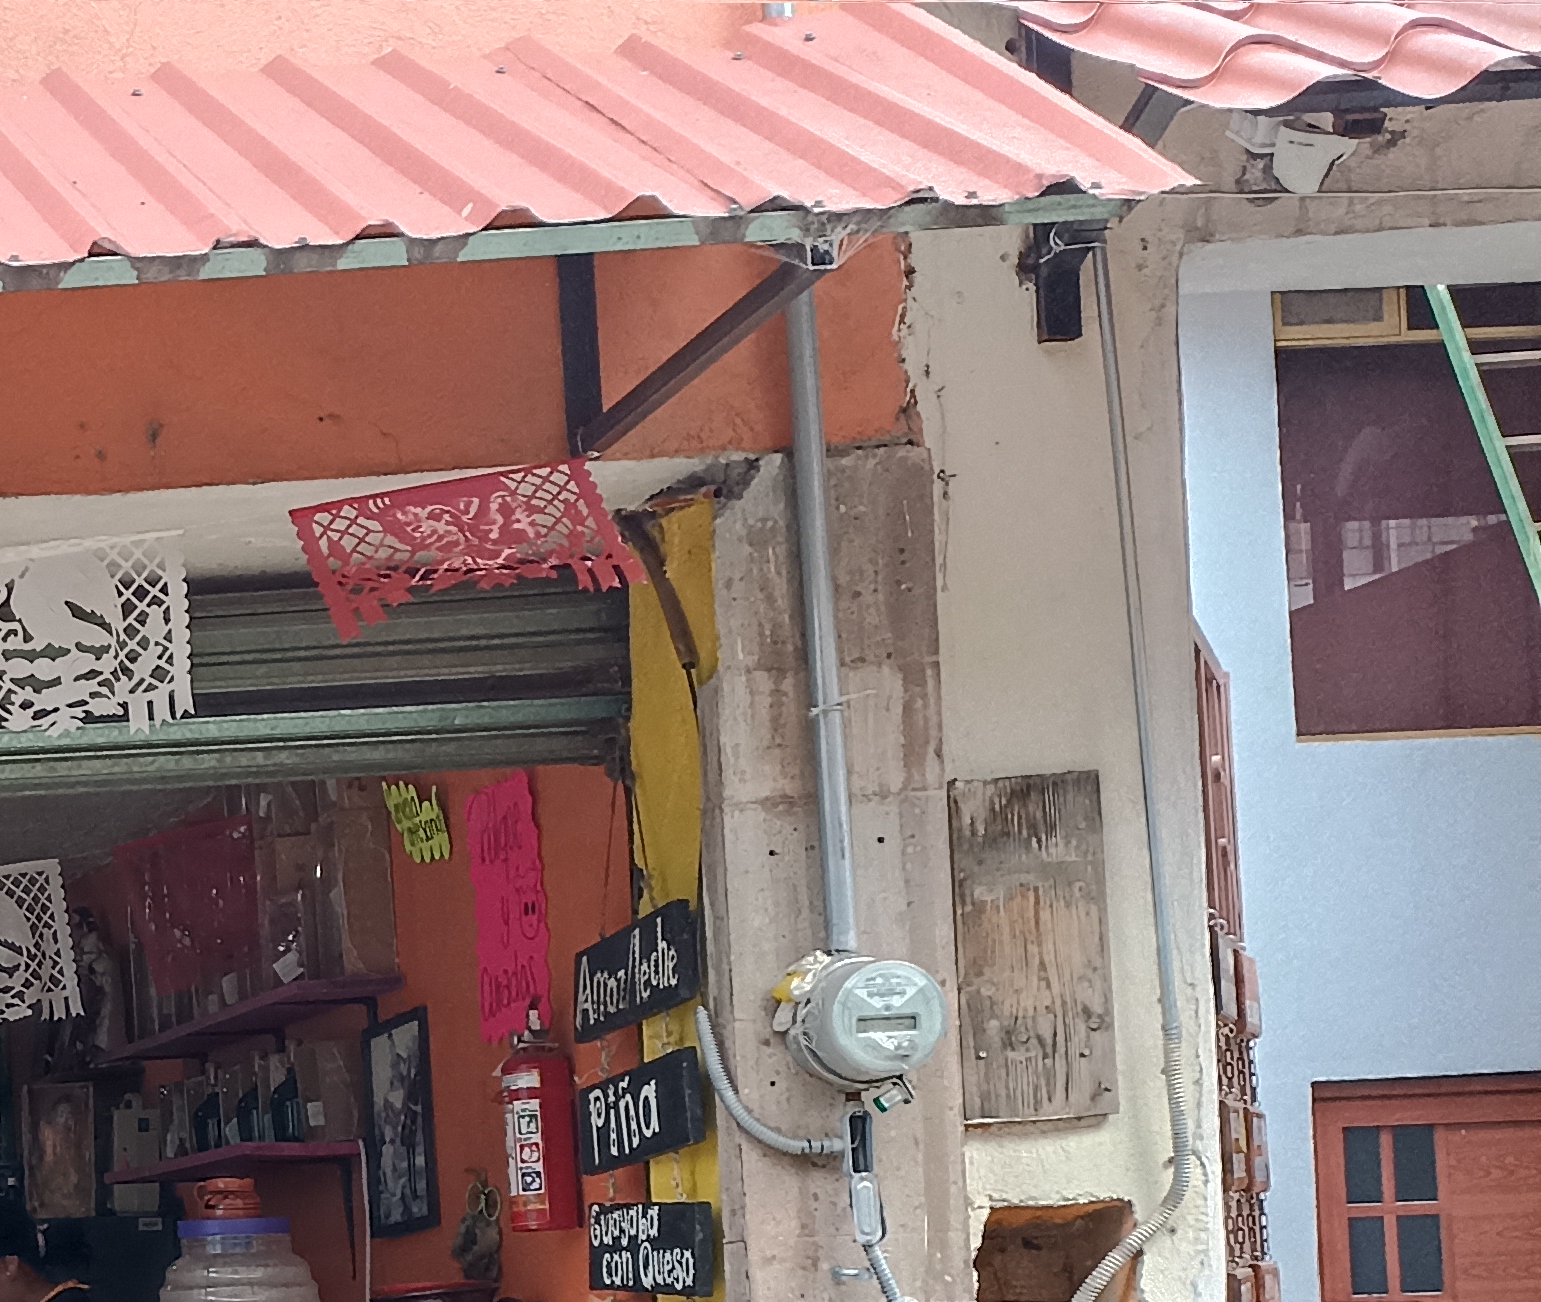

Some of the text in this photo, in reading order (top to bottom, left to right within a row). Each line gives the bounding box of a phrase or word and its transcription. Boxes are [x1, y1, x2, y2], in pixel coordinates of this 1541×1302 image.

[588, 1075, 660, 1166] Piña
[590, 1204, 660, 1248] Guayaba
[602, 1241, 695, 1290] con Queso
